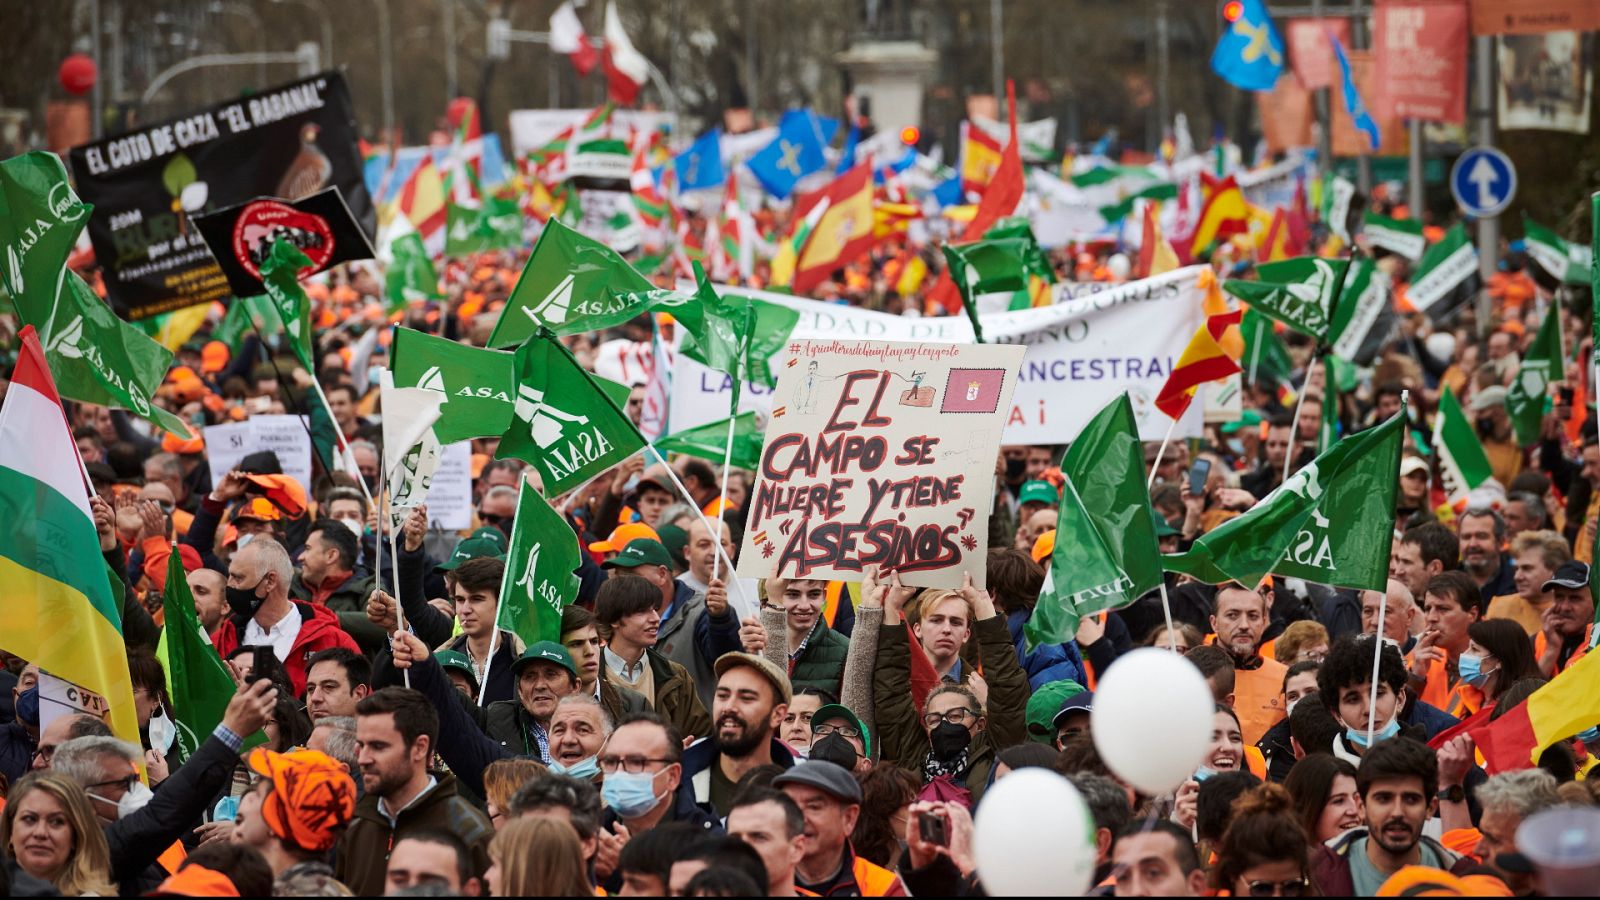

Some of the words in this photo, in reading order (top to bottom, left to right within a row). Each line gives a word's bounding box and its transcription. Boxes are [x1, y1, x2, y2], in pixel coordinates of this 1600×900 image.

[85, 147, 109, 175] EL
[108, 133, 153, 170] COTO
[151, 125, 176, 157] DE
[175, 112, 220, 149] CAZA
[573, 292, 642, 316] ASAJA
[799, 308, 887, 336] EDAD
[454, 385, 516, 404] ASA
[823, 369, 893, 434] EL
[761, 432, 888, 482] CAMPO
[894, 434, 941, 466] SE
[750, 477, 854, 532] MUERE
[860, 477, 893, 532] Y
[886, 474, 964, 510] TIENE
[537, 578, 564, 617] ASA
